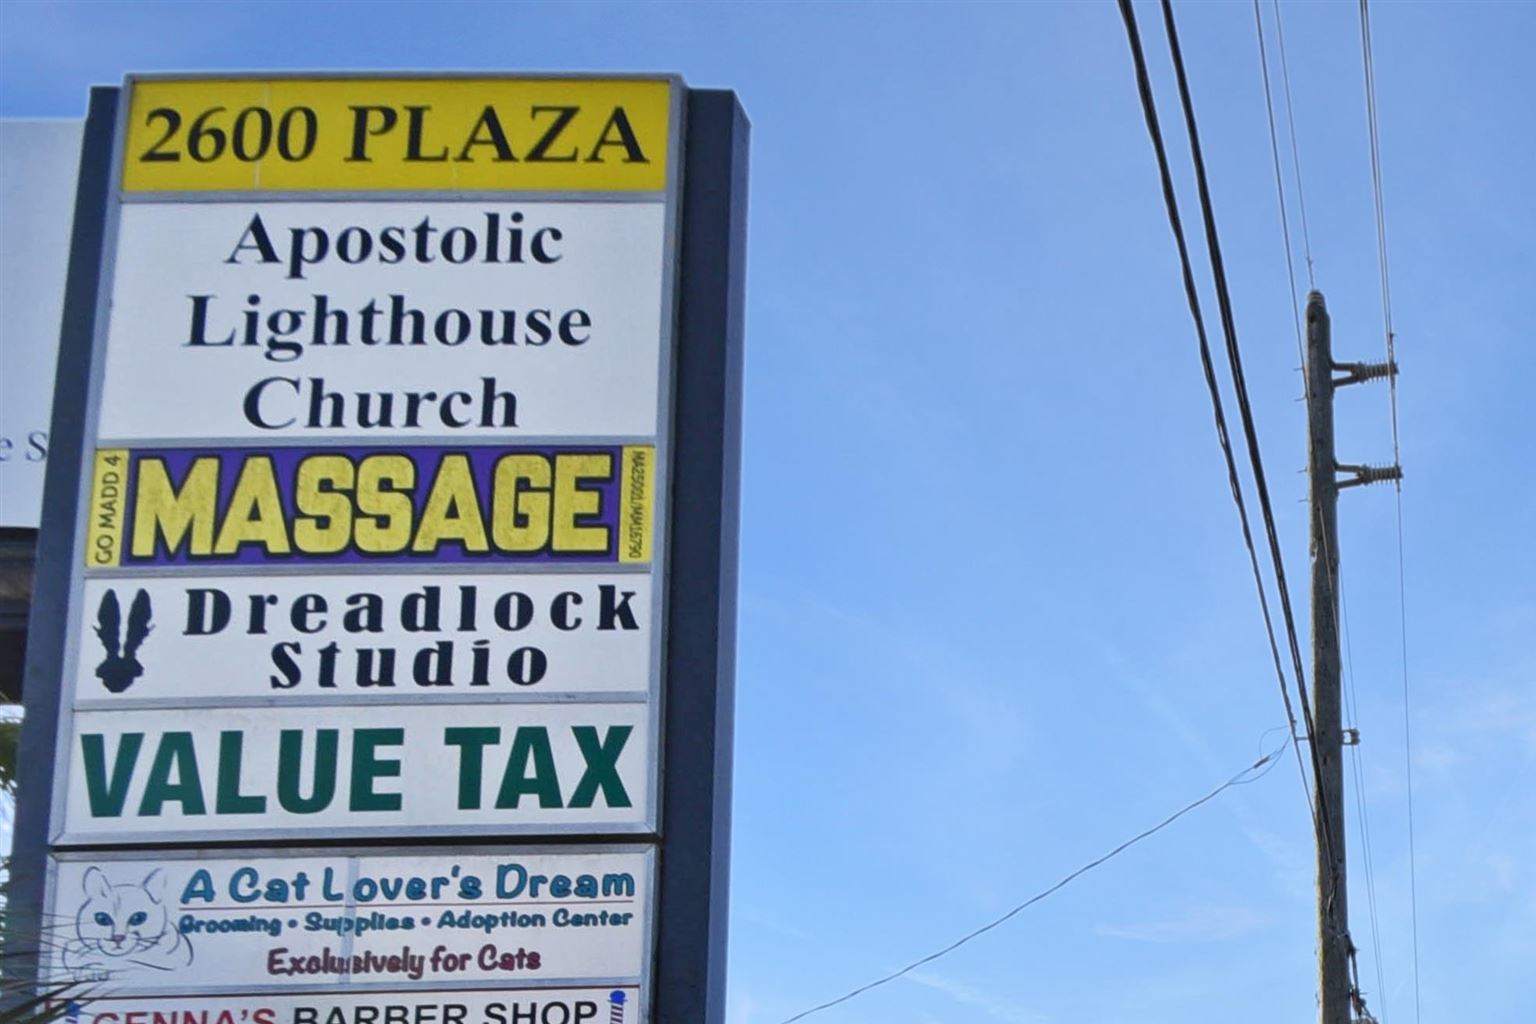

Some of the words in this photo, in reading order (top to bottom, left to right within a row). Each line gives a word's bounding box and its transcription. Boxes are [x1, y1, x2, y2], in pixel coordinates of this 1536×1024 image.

[139, 105, 318, 164] 2600
[344, 104, 651, 165] PLAZA
[223, 212, 565, 280] Apostolic
[183, 295, 592, 362] Lighthouse
[242, 376, 520, 430] Church
[104, 454, 121, 466] 4
[99, 471, 119, 529] MADD
[129, 450, 613, 559] MASSAGE
[95, 534, 114, 563] GO
[182, 584, 640, 636] Dreadlock
[270, 639, 548, 690] Studio
[80, 727, 405, 818] VALUE
[444, 725, 634, 811] TAX
[179, 868, 216, 904] A
[228, 866, 311, 904] Cat
[321, 864, 483, 902] Lover's
[496, 862, 636, 900] Dream
[178, 914, 282, 937] Grooming
[304, 911, 416, 938] Supplies
[436, 909, 546, 934] Adoption
[552, 907, 634, 928] Center
[266, 945, 426, 981] Exclusively
[430, 944, 473, 973] for
[478, 943, 542, 972] Cats
